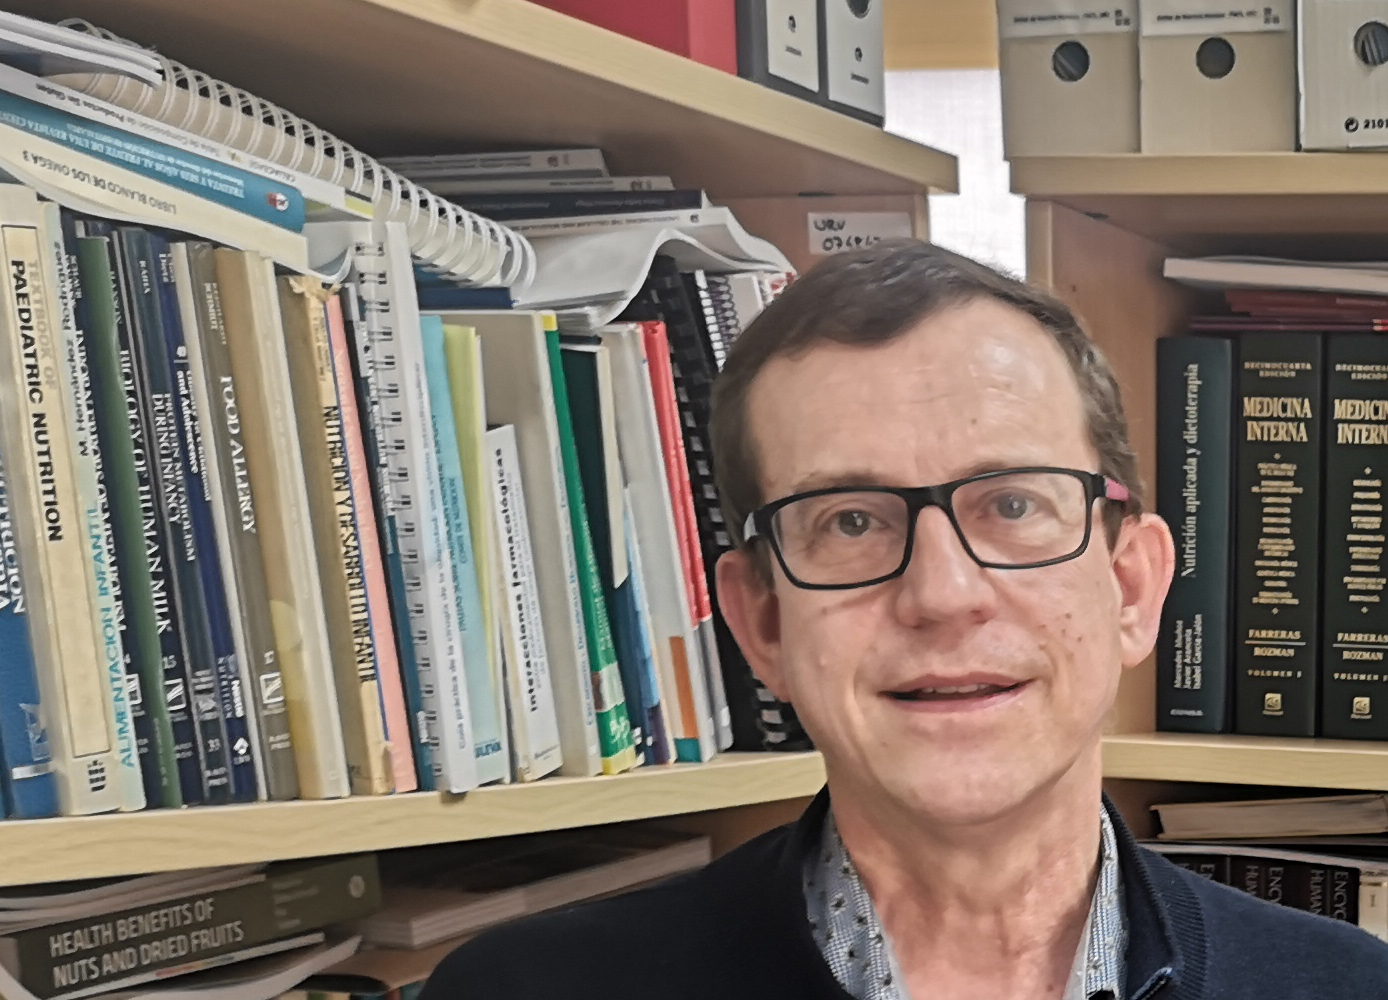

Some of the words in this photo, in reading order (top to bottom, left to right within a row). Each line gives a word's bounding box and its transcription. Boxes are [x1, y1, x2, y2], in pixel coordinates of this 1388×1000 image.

[31, 153, 69, 175] OMEGA
[68, 166, 91, 183] LOS
[90, 174, 108, 189] DE
[106, 181, 148, 204] BLANCO
[147, 195, 178, 215] LIBRO
[27, 260, 51, 362] TEXTBOOK
[42, 365, 56, 390] OF
[11, 259, 43, 405] PAEDIATRIC
[31, 411, 63, 542] NUTRITION
[115, 349, 143, 443] BIOLOGY
[175, 370, 187, 395] and
[219, 374, 241, 434] FOOD
[1182, 363, 1202, 443] dietoterapia
[1243, 397, 1312, 418] MEDICINA
[78, 435, 89, 456] M.
[178, 395, 200, 473] Adolescence
[1185, 446, 1201, 455] y
[1246, 421, 1308, 442] INTERNA
[131, 447, 148, 479] OF
[152, 394, 172, 454] DURING
[162, 457, 181, 526] INFANCY
[163, 394, 182, 456] PROTEIN
[173, 459, 196, 562] METABOLISM
[228, 437, 257, 535] ALLERGY
[1182, 457, 1200, 512] aplicada
[134, 484, 163, 574] HUMAN
[492, 448, 521, 586] farmacológicas
[85, 508, 107, 596] INFANTIL
[1180, 516, 1197, 577] Nutrición
[99, 511, 127, 630] METABOLISM
[149, 577, 173, 634] MILK
[513, 593, 538, 711] Interacciones
[1248, 629, 1301, 639] FARRERAS
[1253, 647, 1295, 657] ROZMAN
[1337, 633, 1388, 643] FARRERAS
[1342, 650, 1384, 660] ROZMAN
[1173, 649, 1181, 688] Mercedes
[1191, 665, 1202, 689] Isabel
[1247, 669, 1293, 677] VOLUMEN
[1333, 673, 1379, 681] VOLUMEN
[47, 922, 116, 959] HEALTH
[113, 901, 195, 943] BENEFITS
[191, 896, 218, 922] OF
[49, 955, 103, 989] NUTS
[97, 945, 140, 976] AND
[136, 931, 191, 967] DRIED
[186, 918, 246, 954] FRUITS
